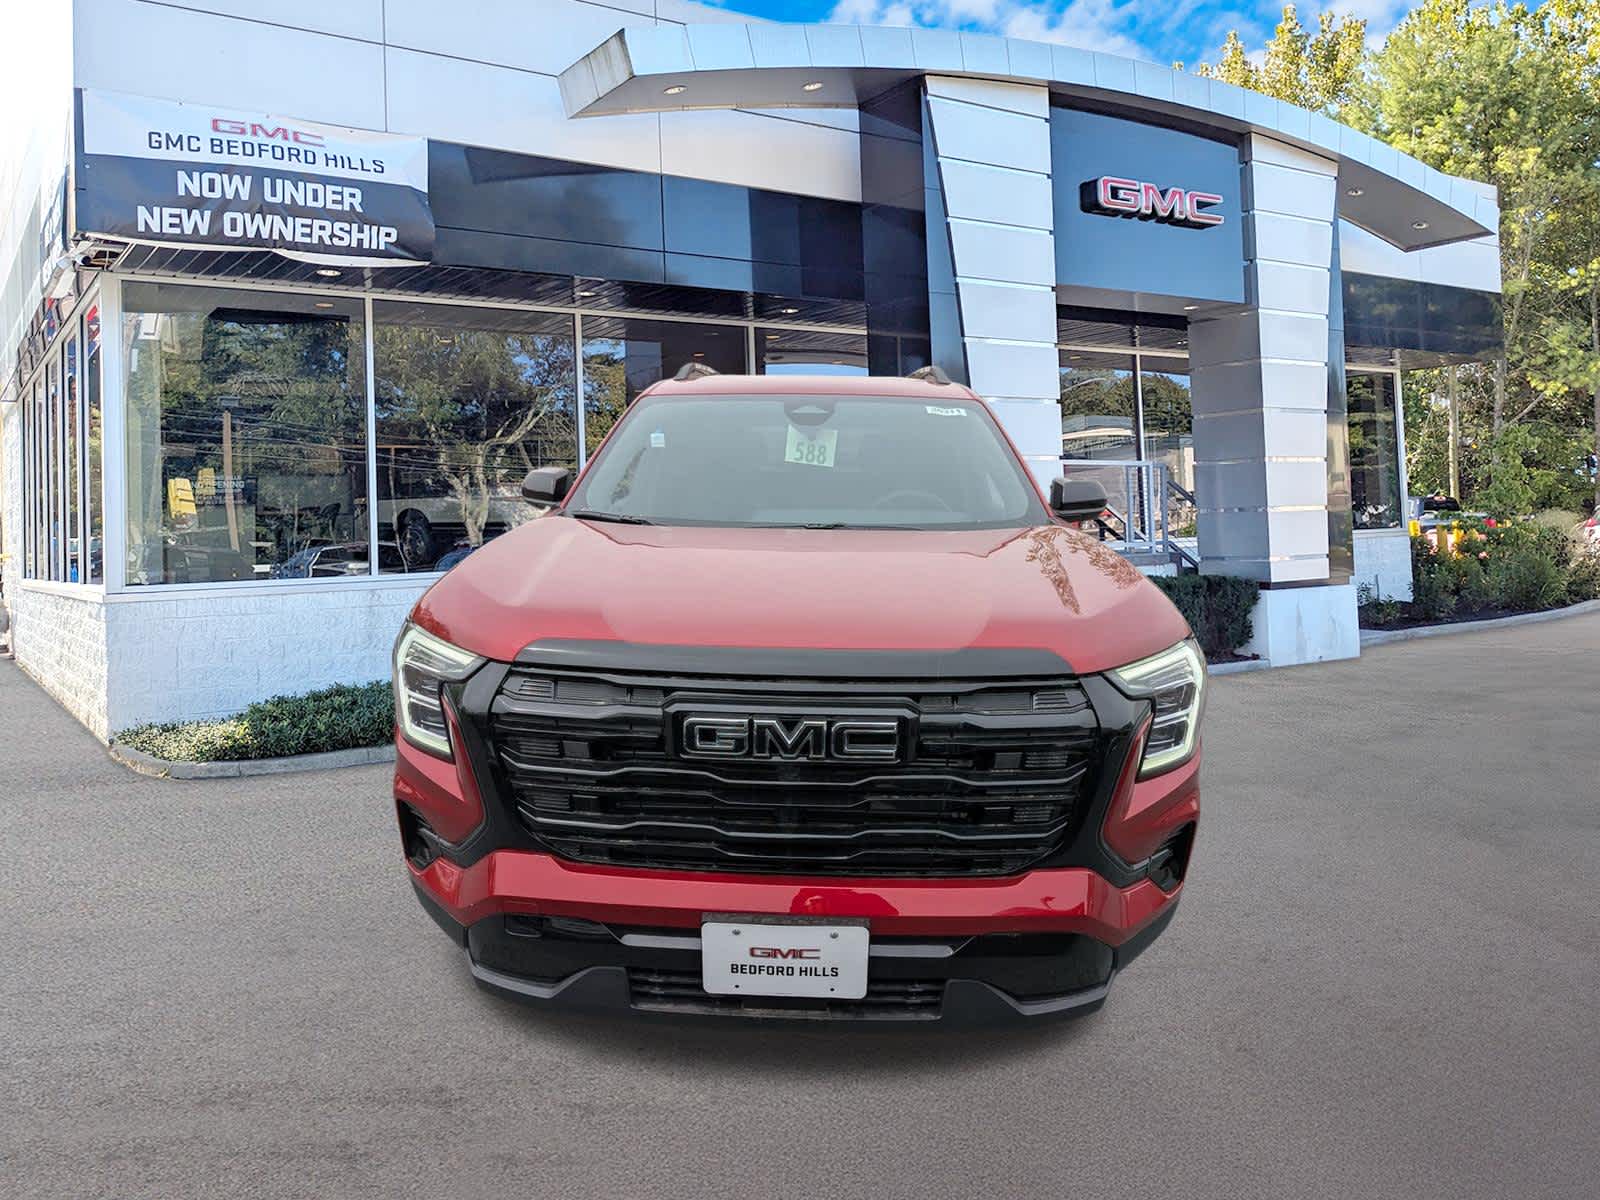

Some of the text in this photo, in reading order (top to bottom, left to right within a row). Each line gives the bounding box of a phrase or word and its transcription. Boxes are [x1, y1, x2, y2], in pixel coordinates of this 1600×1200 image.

[147, 131, 385, 174] GMC BEDFORD HILLS
[211, 118, 326, 147] GMC
[177, 170, 364, 213] NOW UNDER
[1097, 175, 1225, 224] GMC
[136, 205, 398, 250] NEW OWNERSHIP
[794, 442, 827, 464] 588
[682, 716, 899, 761] GMC
[730, 963, 839, 977] BEDFORD HILLS
[749, 947, 821, 960] GMC
